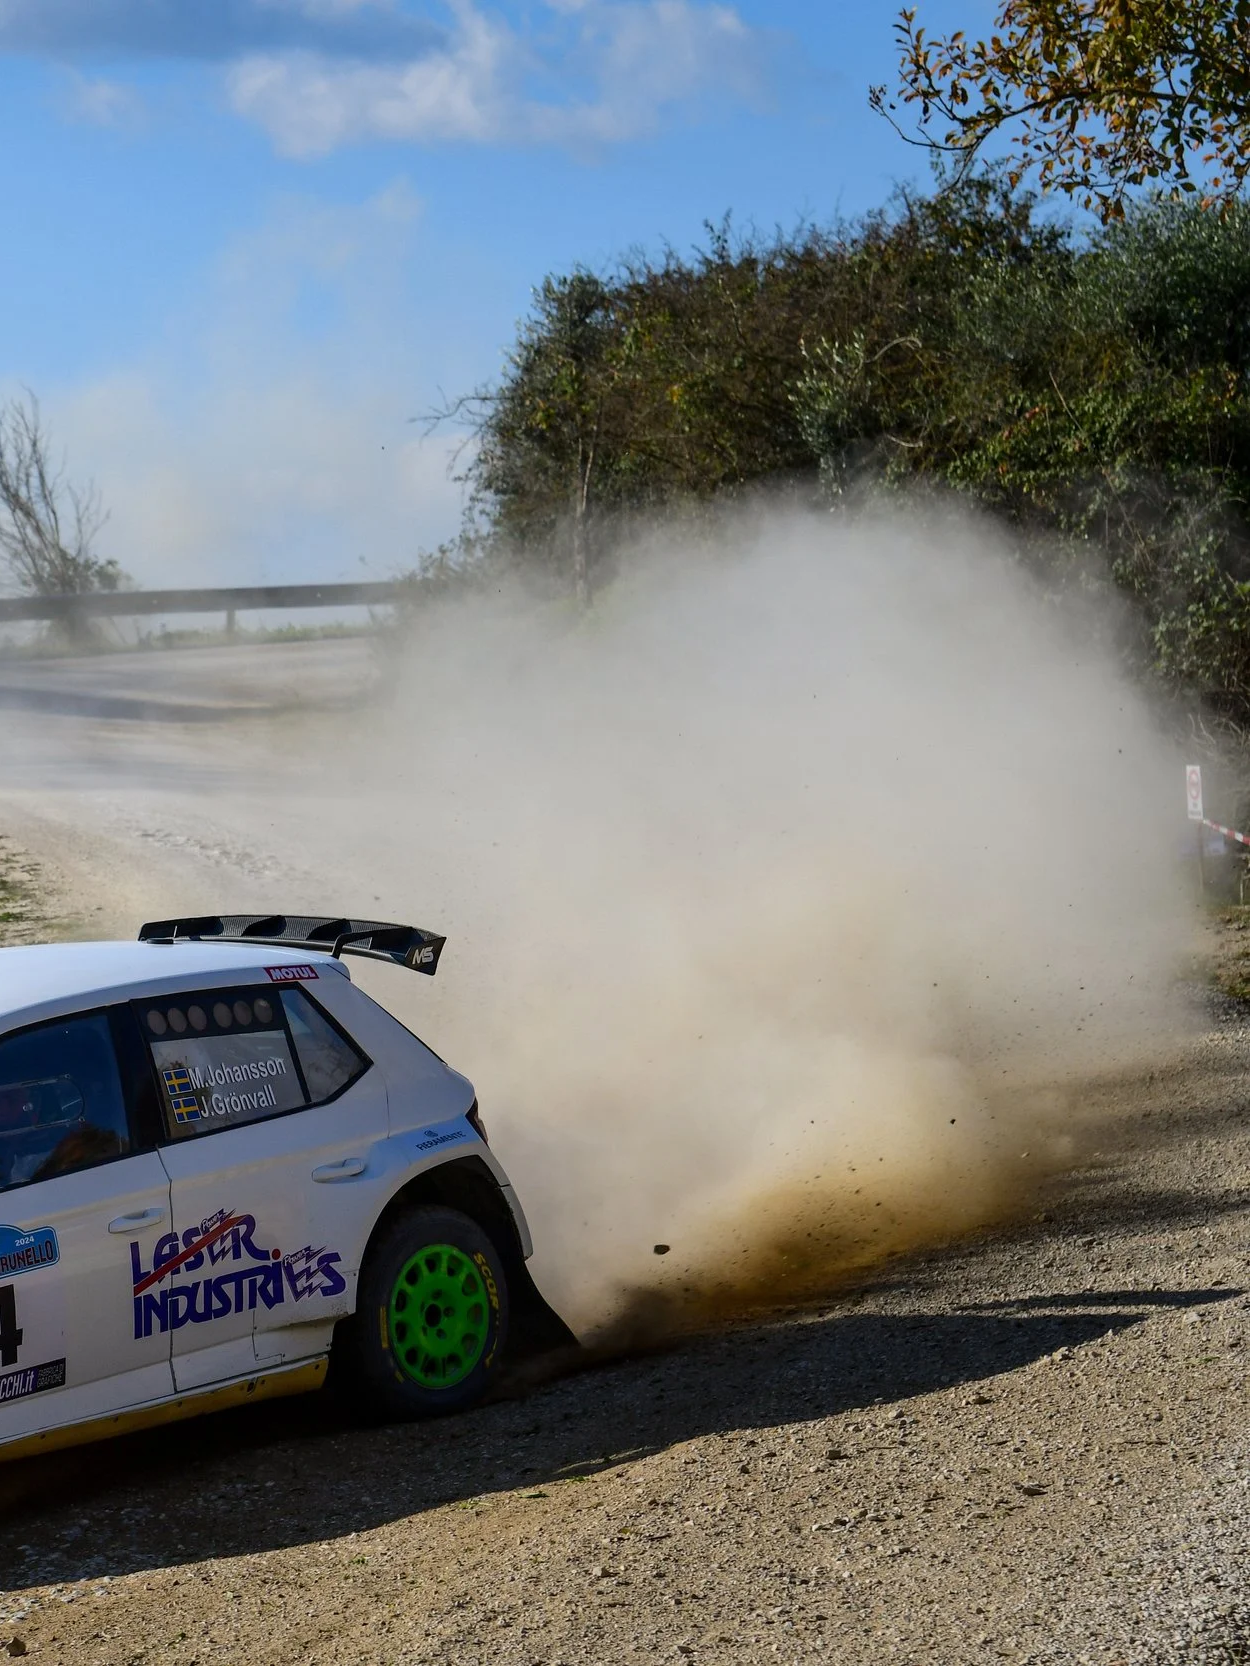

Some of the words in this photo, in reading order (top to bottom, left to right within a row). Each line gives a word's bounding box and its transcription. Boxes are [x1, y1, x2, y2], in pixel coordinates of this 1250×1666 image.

[412, 946, 434, 965] MS
[270, 966, 316, 980] MOTUL
[188, 1058, 287, 1090] M.Johansson
[201, 1084, 277, 1118] J.Grönvall
[15, 1235, 35, 1247] 2024
[134, 1248, 346, 1340] INDUSTRIES
